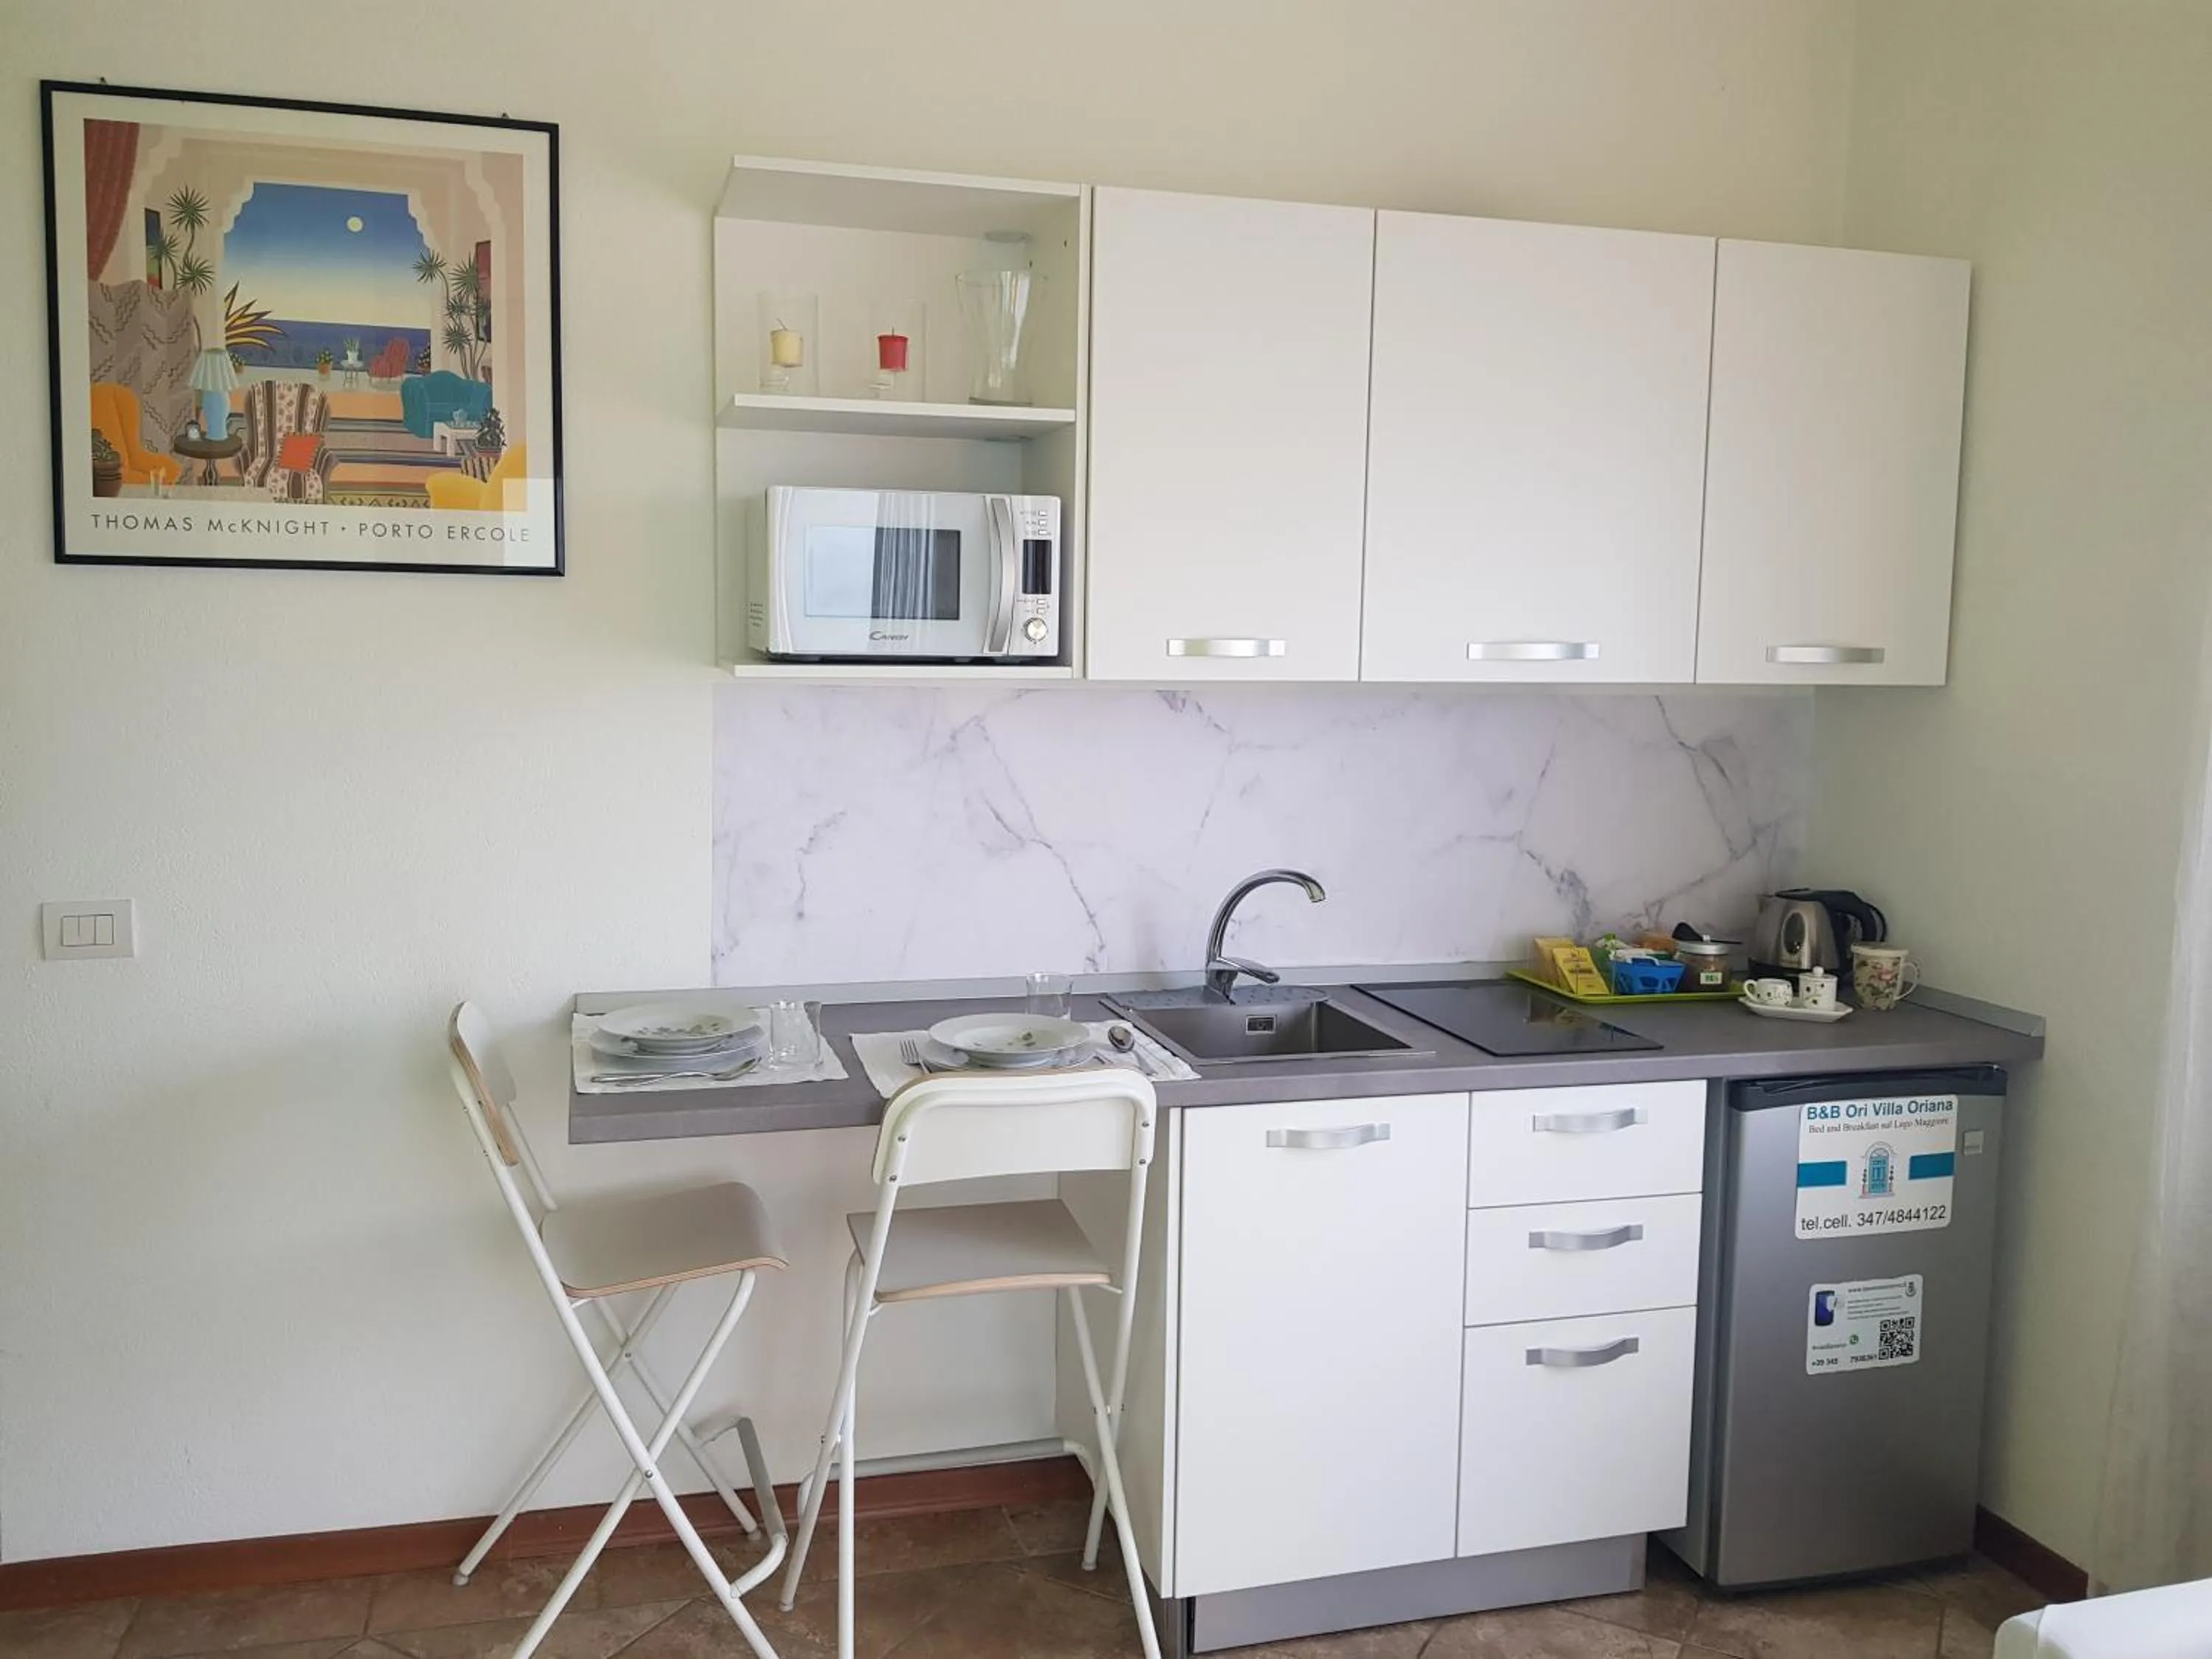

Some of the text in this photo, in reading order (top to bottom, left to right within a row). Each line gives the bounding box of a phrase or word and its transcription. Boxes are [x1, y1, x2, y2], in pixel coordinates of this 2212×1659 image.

[91, 514, 529, 543] THOMAS McKNIGHT PORTO ERCOLE
[1806, 1099, 1954, 1120] B&B Ori Villa Oriana
[1809, 1124, 1825, 1133] Bed
[1826, 1123, 1842, 1133] and
[1843, 1121, 1879, 1132] Breakfast
[1801, 1204, 1947, 1231] tel.cell. 347/4844122
